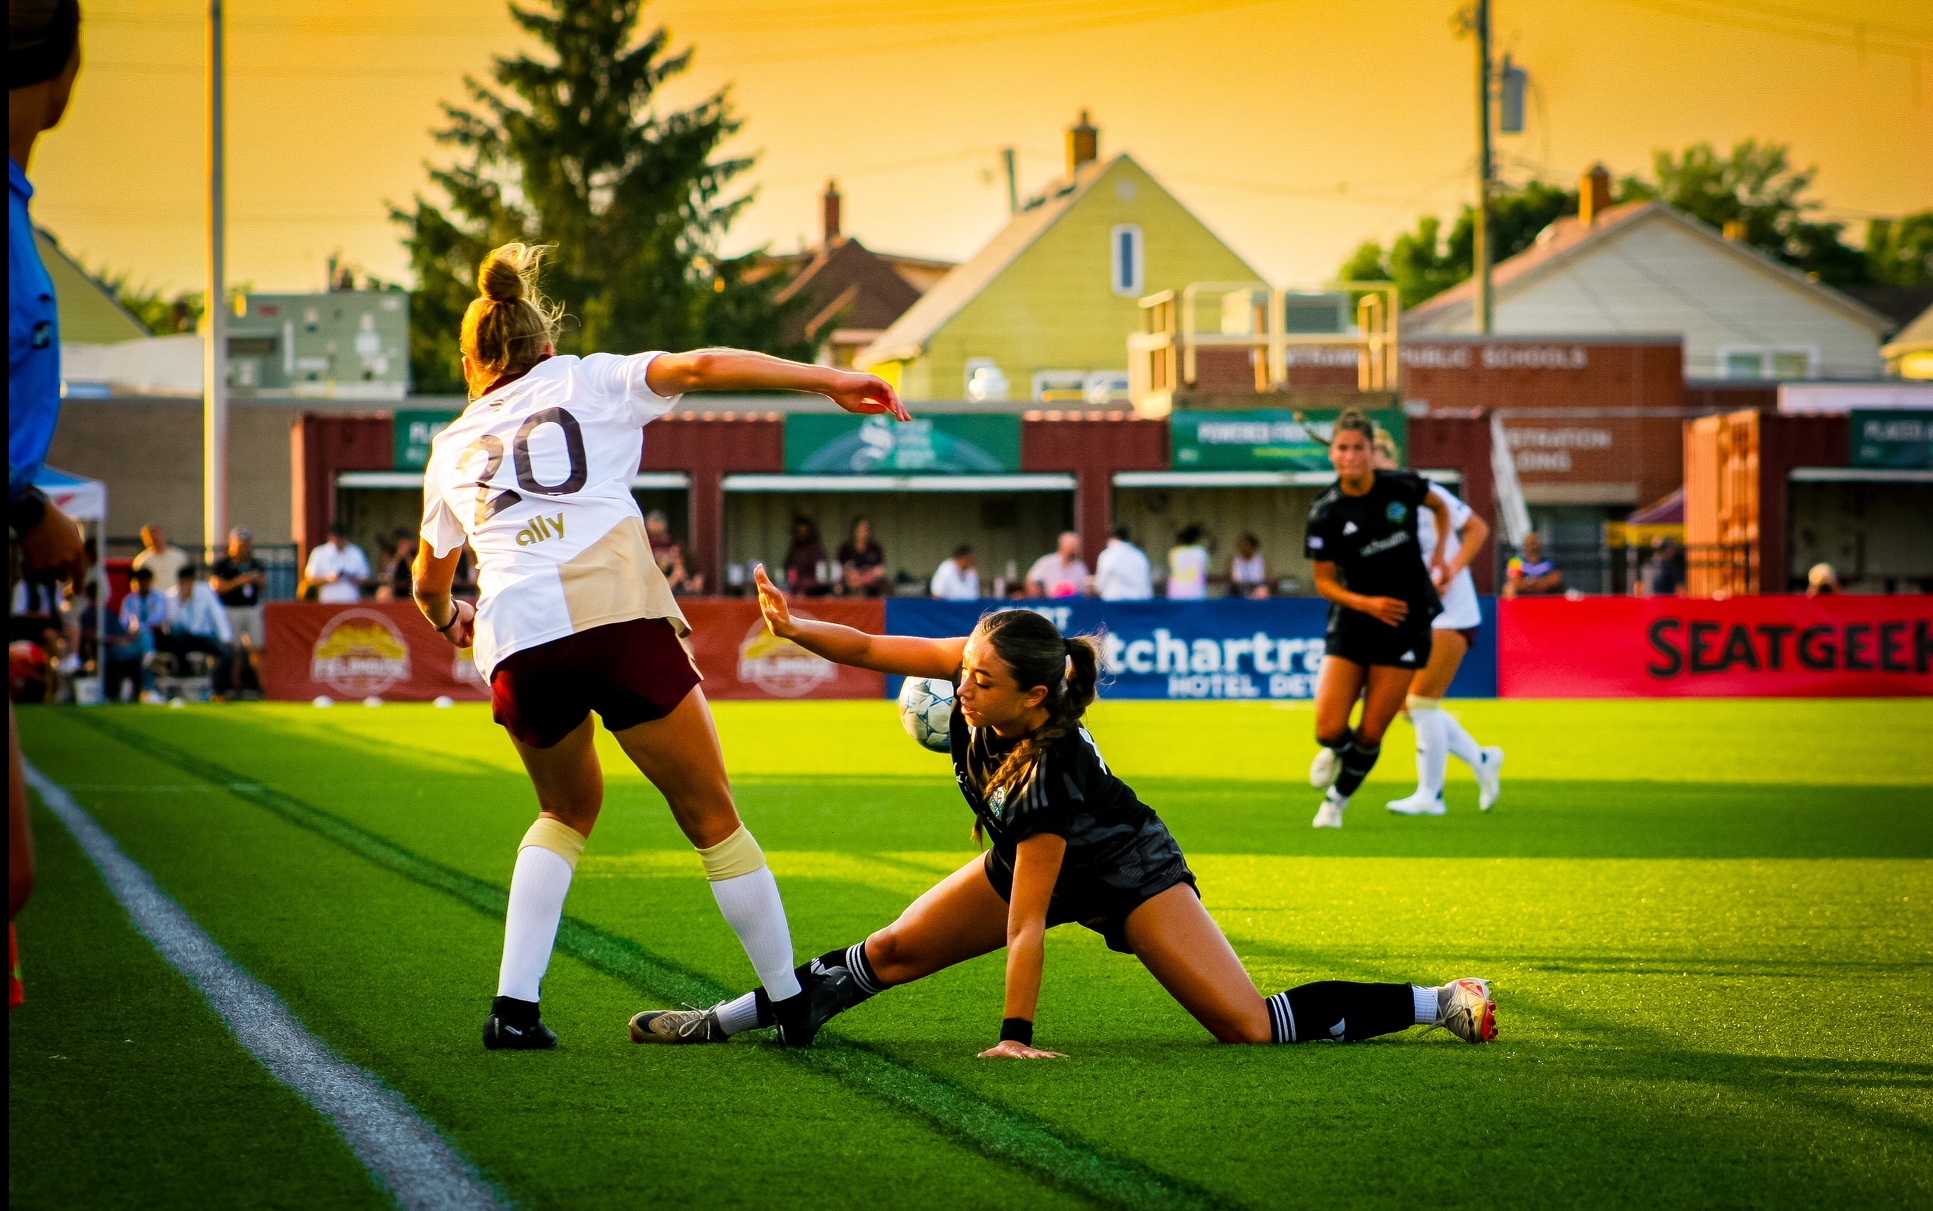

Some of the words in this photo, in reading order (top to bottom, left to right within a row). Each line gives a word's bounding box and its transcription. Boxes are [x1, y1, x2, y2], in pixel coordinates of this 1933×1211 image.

[1482, 347, 1588, 369] SCHOOLS
[1506, 428, 1613, 450] STRATION
[456, 406, 588, 526] 20
[516, 512, 566, 547] ally
[1102, 628, 1326, 675] tchartra
[1168, 674, 1261, 698] HOTEL
[1269, 674, 1320, 698] DET
